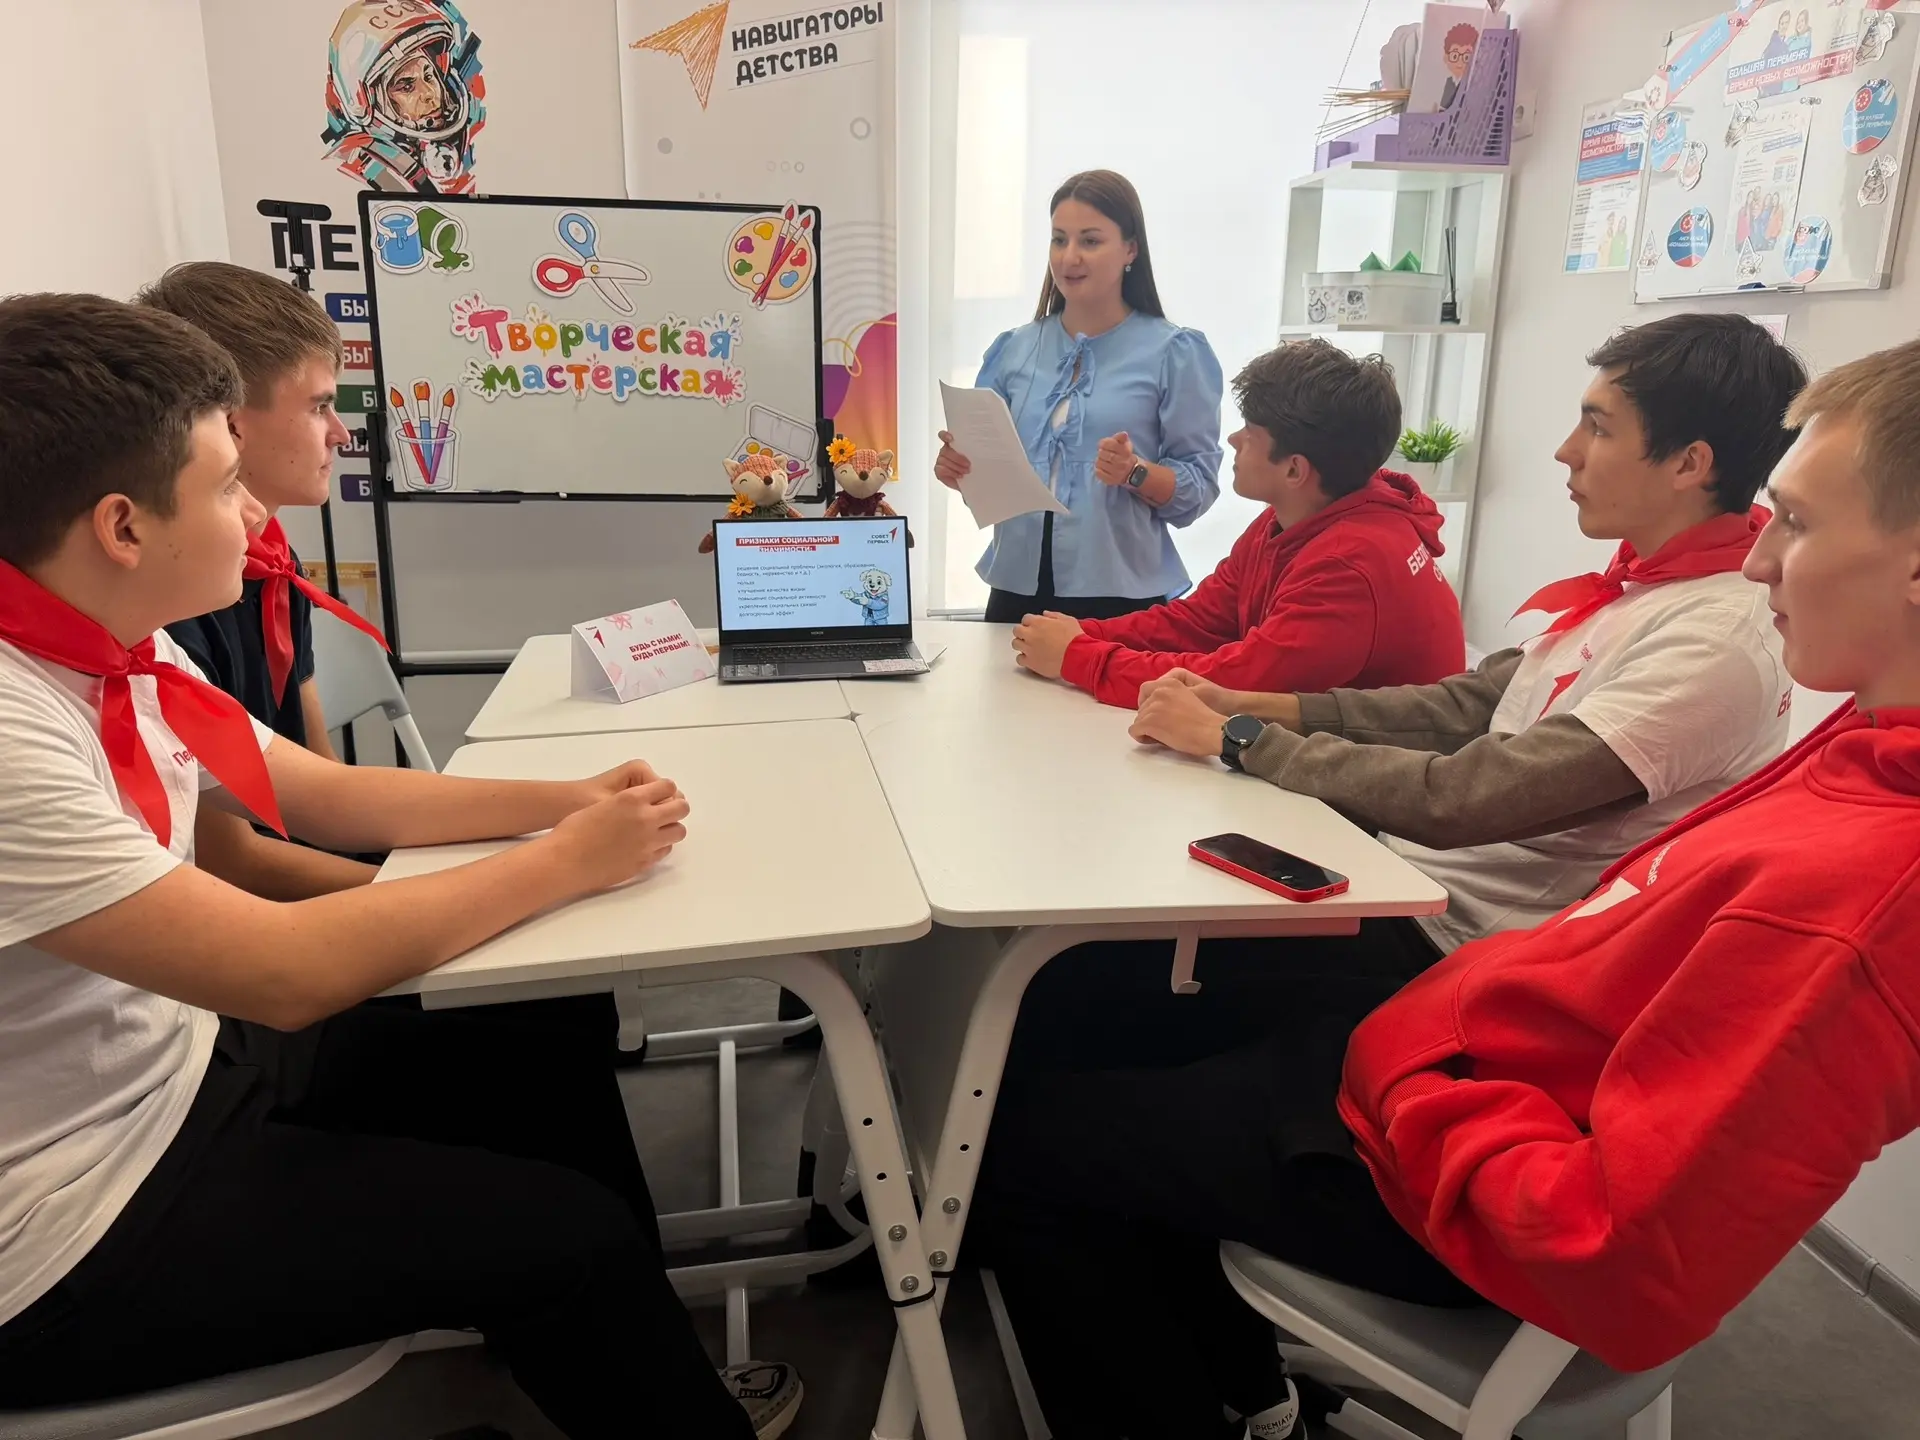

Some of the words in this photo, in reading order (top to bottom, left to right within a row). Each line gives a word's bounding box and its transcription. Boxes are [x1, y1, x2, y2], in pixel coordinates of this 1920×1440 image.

[731, 2, 883, 51] НАВИГАТОРЫ
[736, 42, 838, 86] ДЕТСТВА
[1729, 60, 1765, 79] БОЛЬШАЯ
[1729, 77, 1755, 93] ВРЕМЯ
[1756, 72, 1781, 85] НОВЫХ
[1783, 49, 1853, 79] ВОЗМОЖНОСТЕЙ
[1584, 124, 1611, 138] БОЛЬШАЯ
[468, 309, 732, 358] Творческая
[482, 363, 738, 399] мастерская
[738, 537, 780, 545] ПРИЗНАКИ
[629, 641, 651, 653] БУДЬ
[656, 633, 683, 646] НАМИ!
[632, 650, 654, 661] БУДЬ
[654, 640, 691, 656] ПЕРВЫМ!
[1256, 1412, 1293, 1431] PREMIATA
